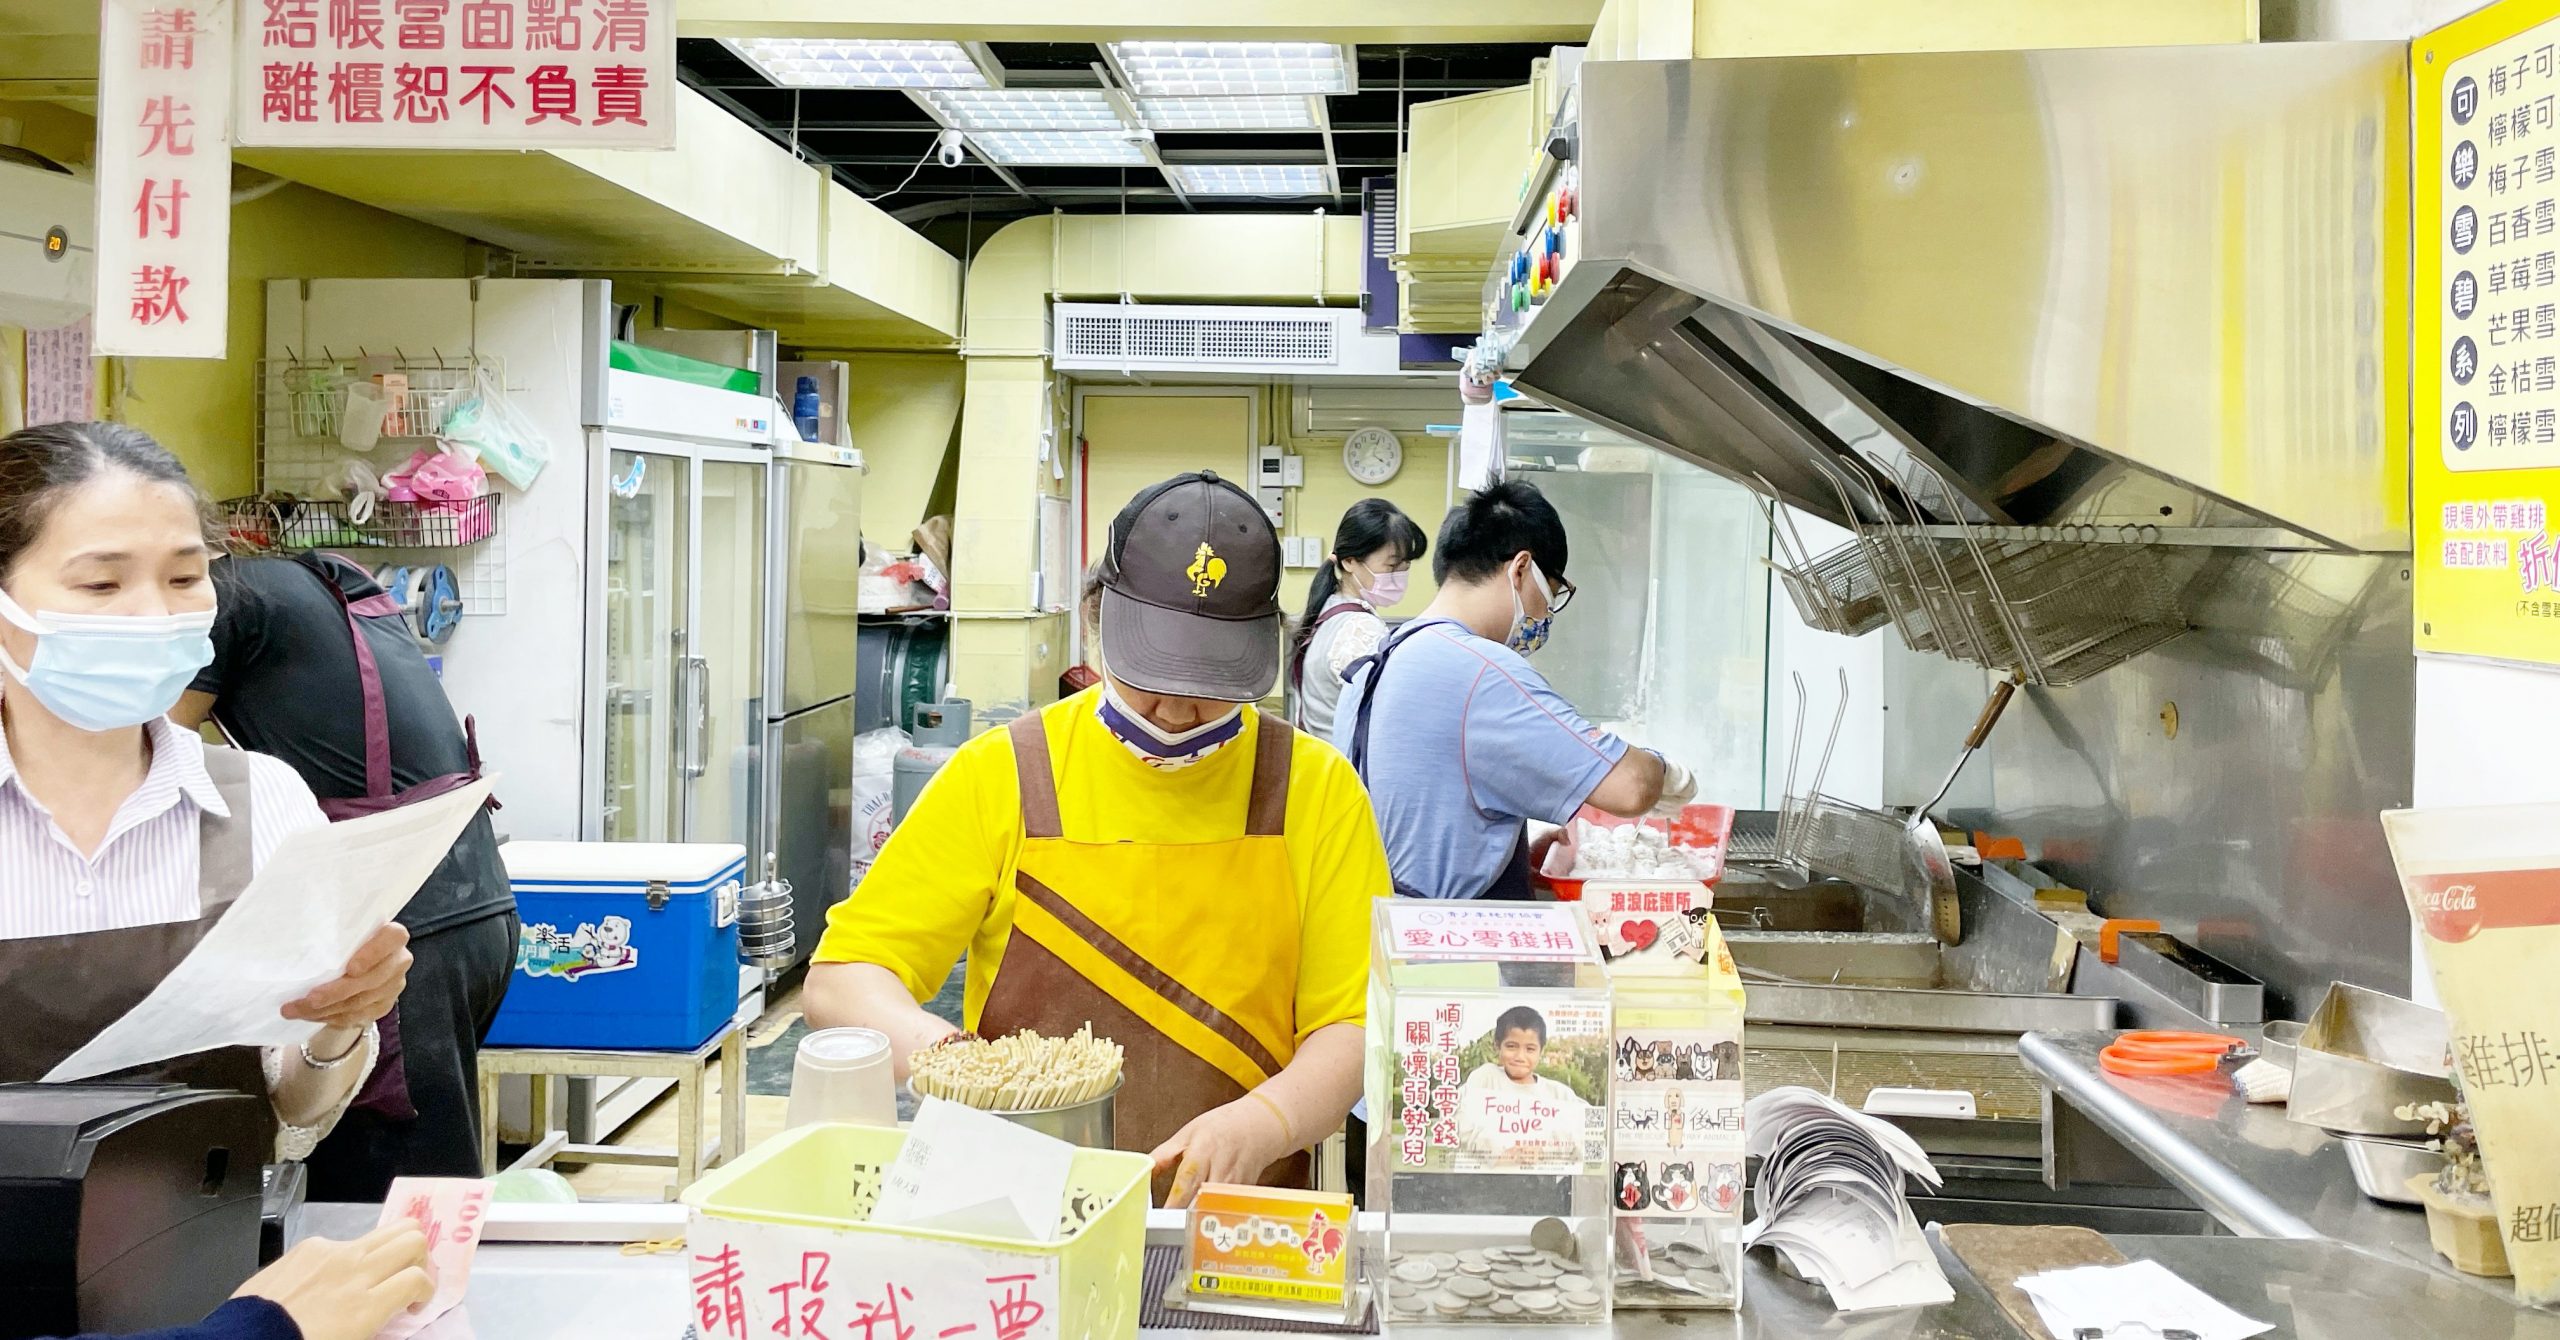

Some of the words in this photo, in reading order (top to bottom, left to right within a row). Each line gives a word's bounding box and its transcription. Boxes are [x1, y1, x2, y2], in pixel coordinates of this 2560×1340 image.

[262, 0, 650, 53] 結帳當面點清
[262, 61, 650, 127] 離櫃恕不負責
[2488, 43, 2560, 100] 梅子可
[2488, 94, 2560, 149] 檸檬可
[131, 7, 197, 327] 請先付款
[2488, 147, 2556, 198] 梅子雪
[2488, 198, 2556, 248] 百香雪
[2488, 250, 2556, 297] 草莓雪
[2488, 303, 2556, 346] 芒果雪
[2488, 356, 2556, 397] 金桔雪
[2488, 408, 2556, 447] 檸檬雪
[2444, 503, 2545, 529] 現場外帶雞排
[2444, 542, 2507, 566] 搭配飲料
[1611, 892, 1691, 913] 浪浪庇護所
[1404, 928, 1575, 950] 愛心零錢捐
[1434, 1003, 1462, 1146] 順手捐零錢
[2458, 1032, 2560, 1091] 雞排
[1403, 1021, 1431, 1164] 關懷弱勢兒
[1484, 1096, 1520, 1115] Food
[1530, 1100, 1560, 1118] for
[1499, 1116, 1543, 1134] Love
[452, 1190, 486, 1243] 100
